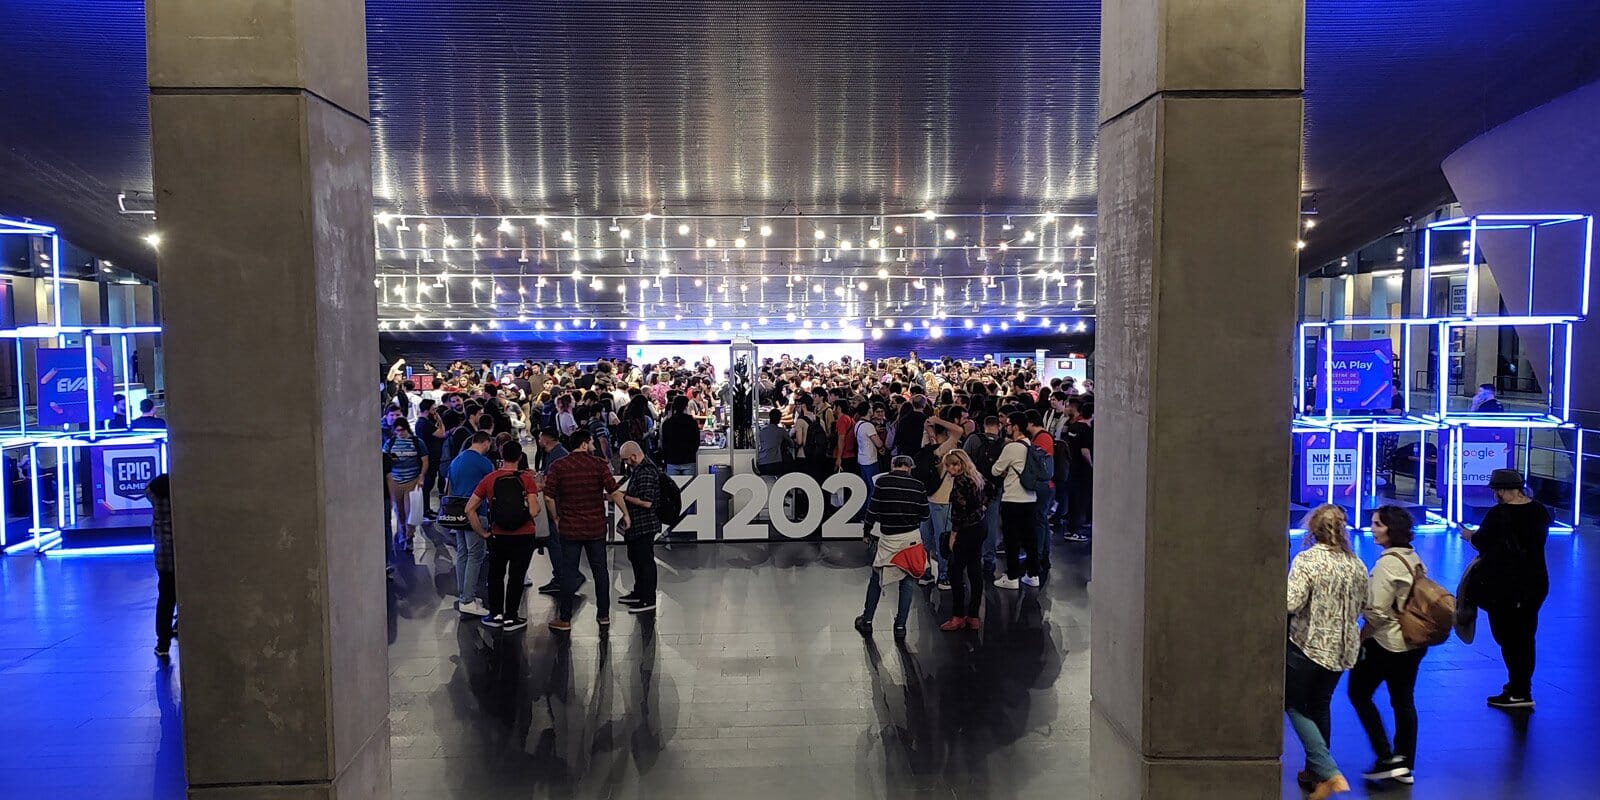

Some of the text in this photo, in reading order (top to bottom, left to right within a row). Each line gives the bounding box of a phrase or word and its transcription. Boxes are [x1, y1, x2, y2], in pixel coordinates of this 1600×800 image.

[1350, 360, 1373, 371] Play
[57, 377, 89, 392] EVA
[1312, 453, 1352, 463] NIMBLE
[118, 461, 151, 481] EPIC
[119, 482, 147, 491] GAME
